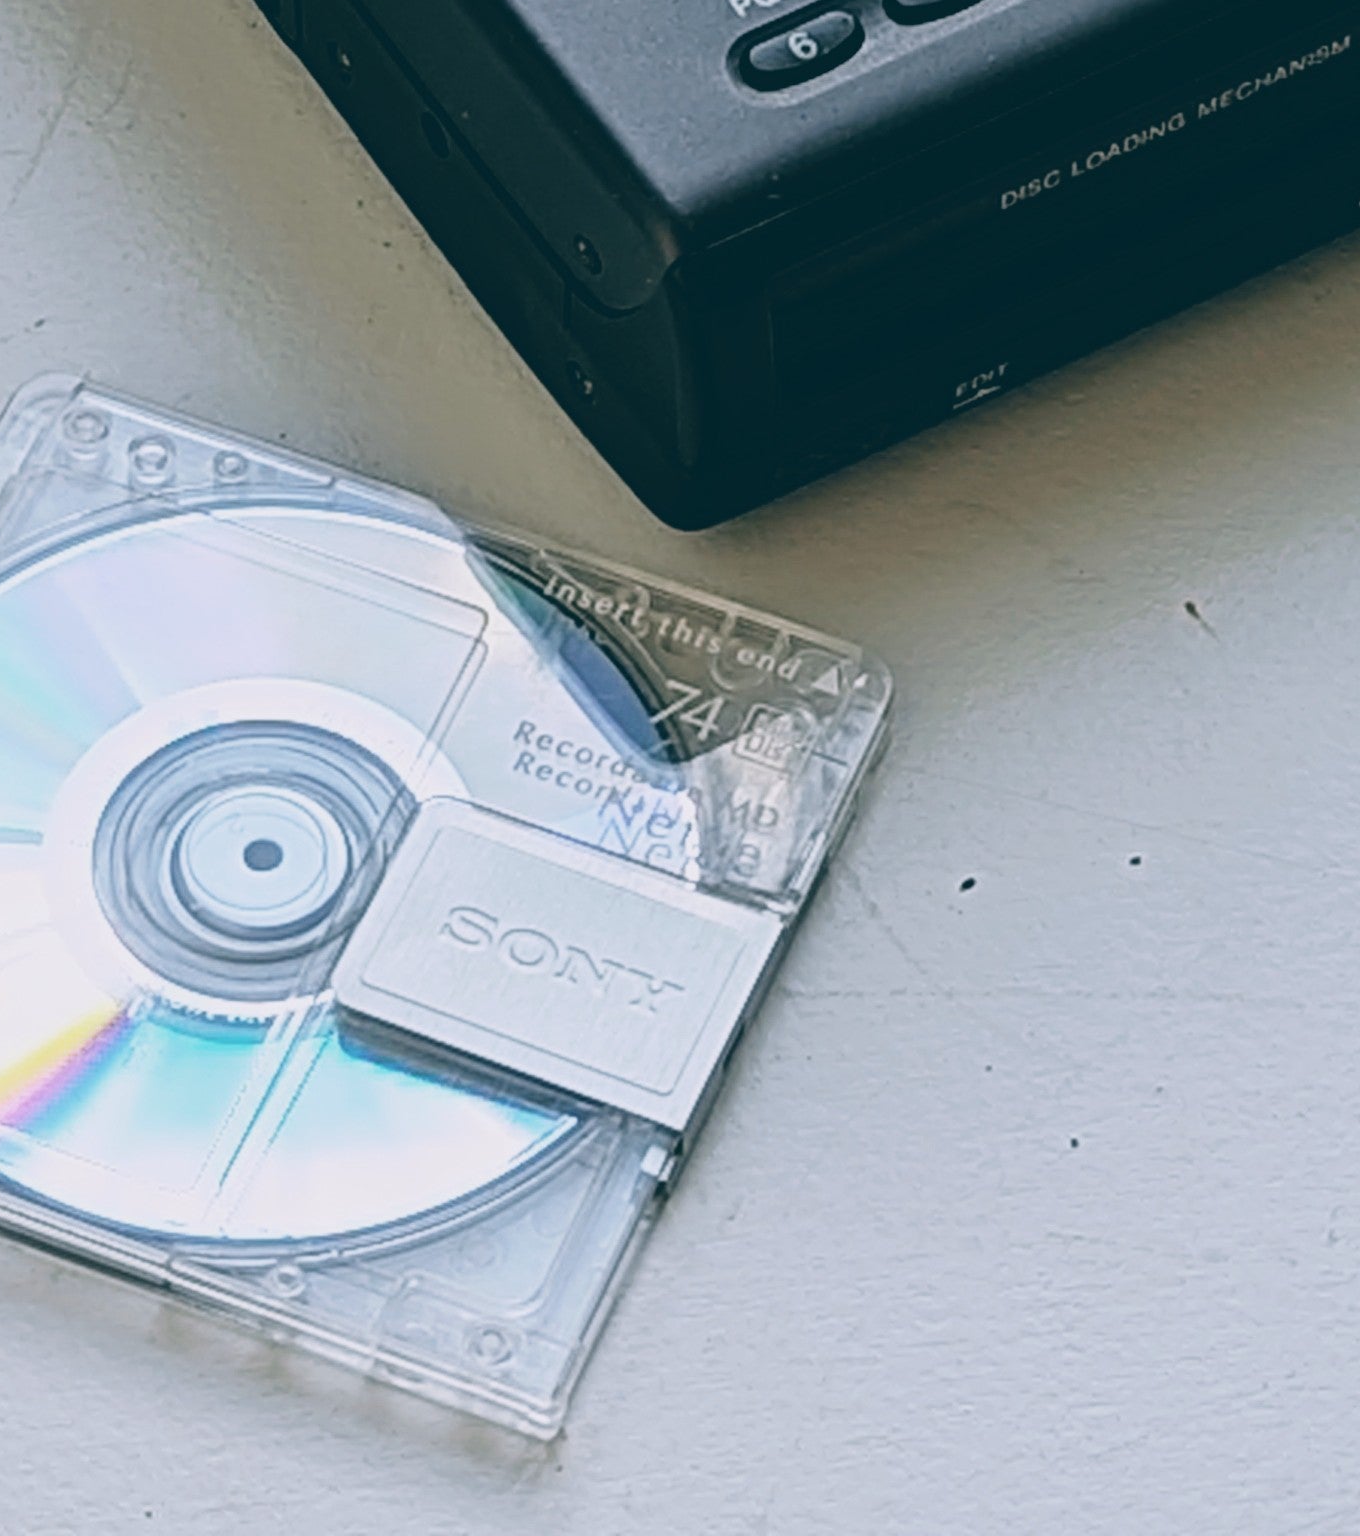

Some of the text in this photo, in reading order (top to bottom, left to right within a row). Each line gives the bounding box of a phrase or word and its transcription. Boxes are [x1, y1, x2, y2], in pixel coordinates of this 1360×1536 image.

[787, 31, 819, 61] 6
[1000, 35, 1351, 210] DISC LOADING MECHANISM
[543, 574, 803, 681] Insert this end
[650, 679, 725, 741] 74
[439, 905, 687, 1013] SONY
